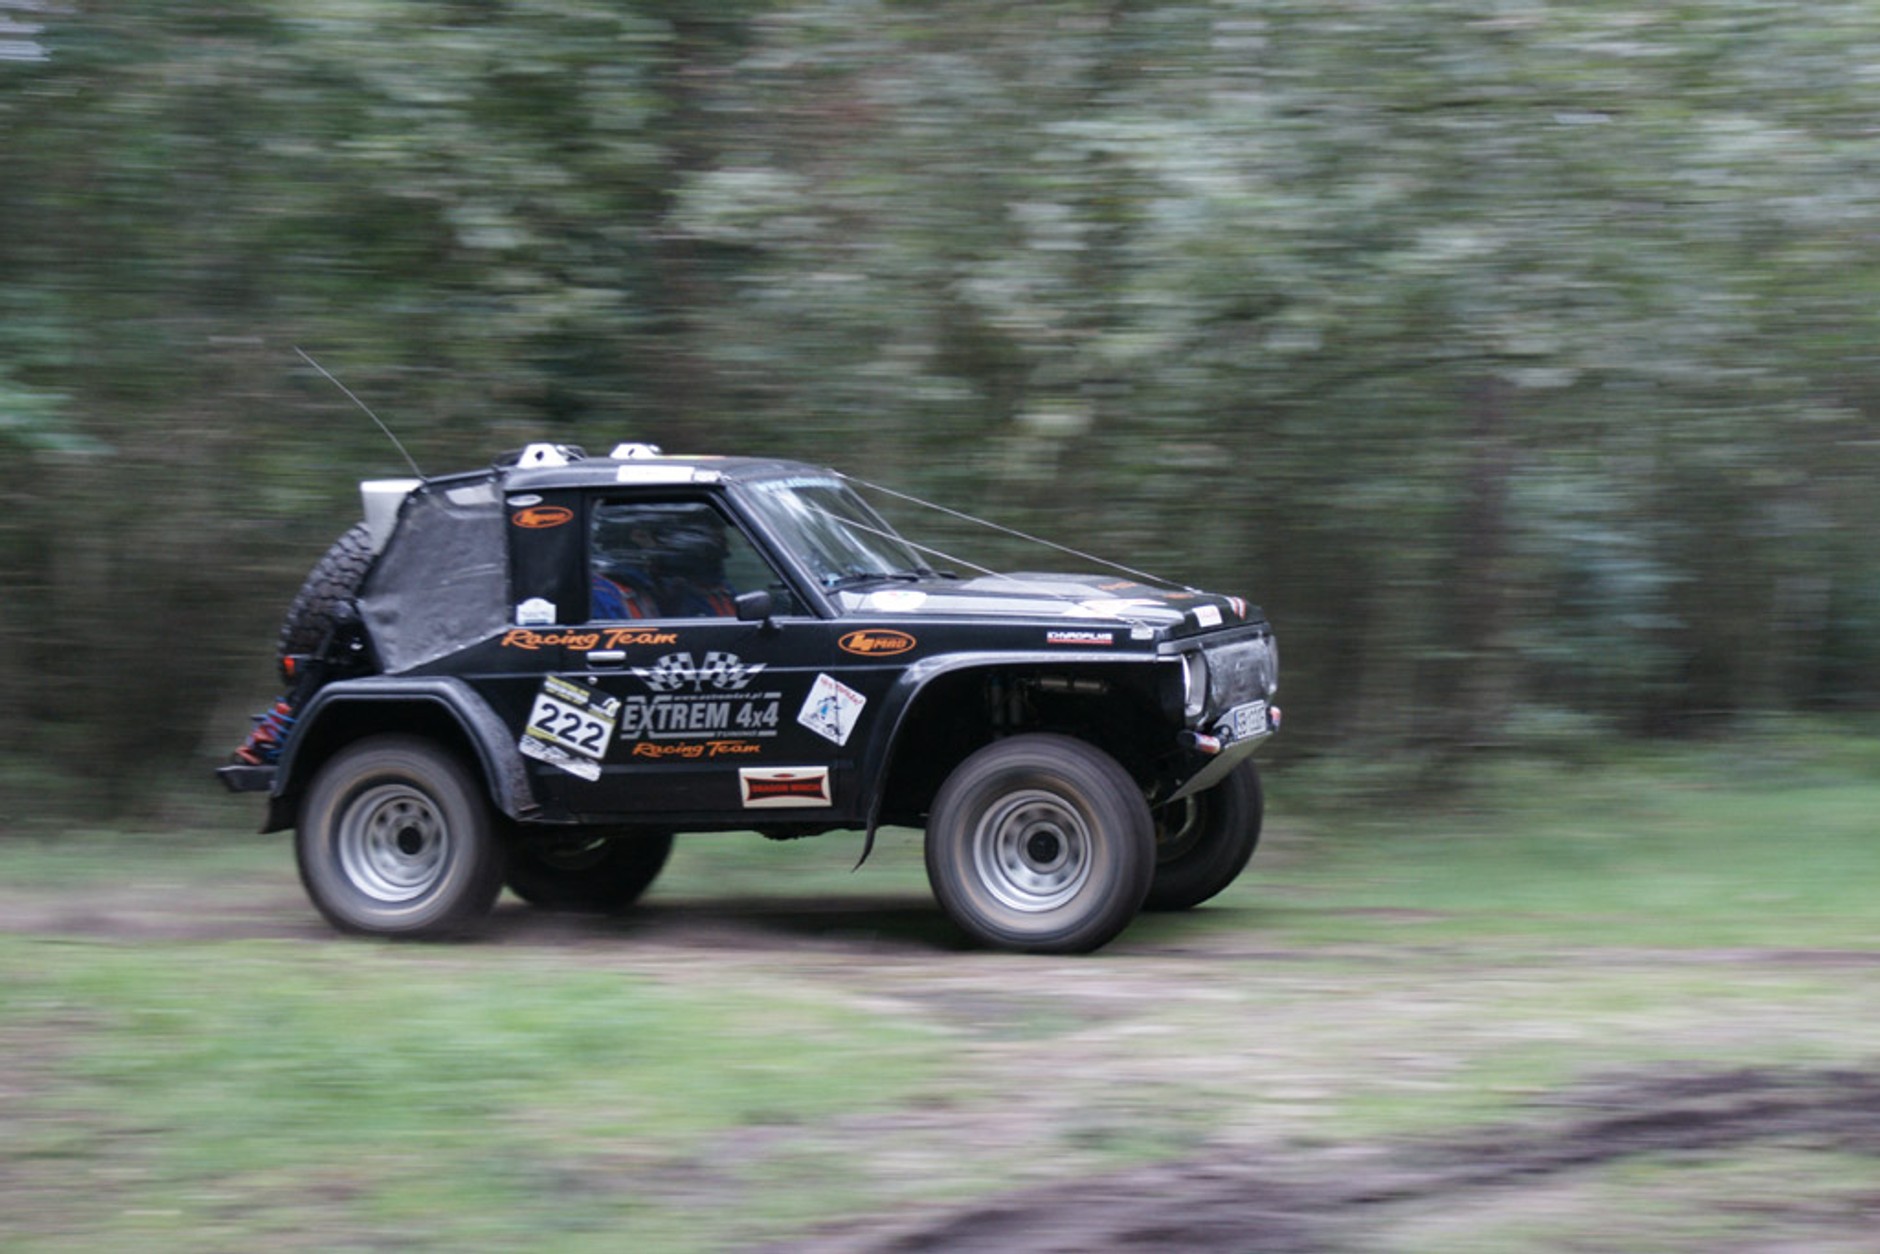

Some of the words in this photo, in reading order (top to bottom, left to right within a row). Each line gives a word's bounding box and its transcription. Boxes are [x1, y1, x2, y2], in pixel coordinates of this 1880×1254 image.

[502, 628, 599, 650] Racing
[602, 628, 678, 650] Team
[534, 702, 605, 754] 222
[621, 702, 730, 731] EXTREM
[735, 701, 779, 728] 4x4
[631, 741, 704, 758] Racing
[705, 740, 761, 758] Team
